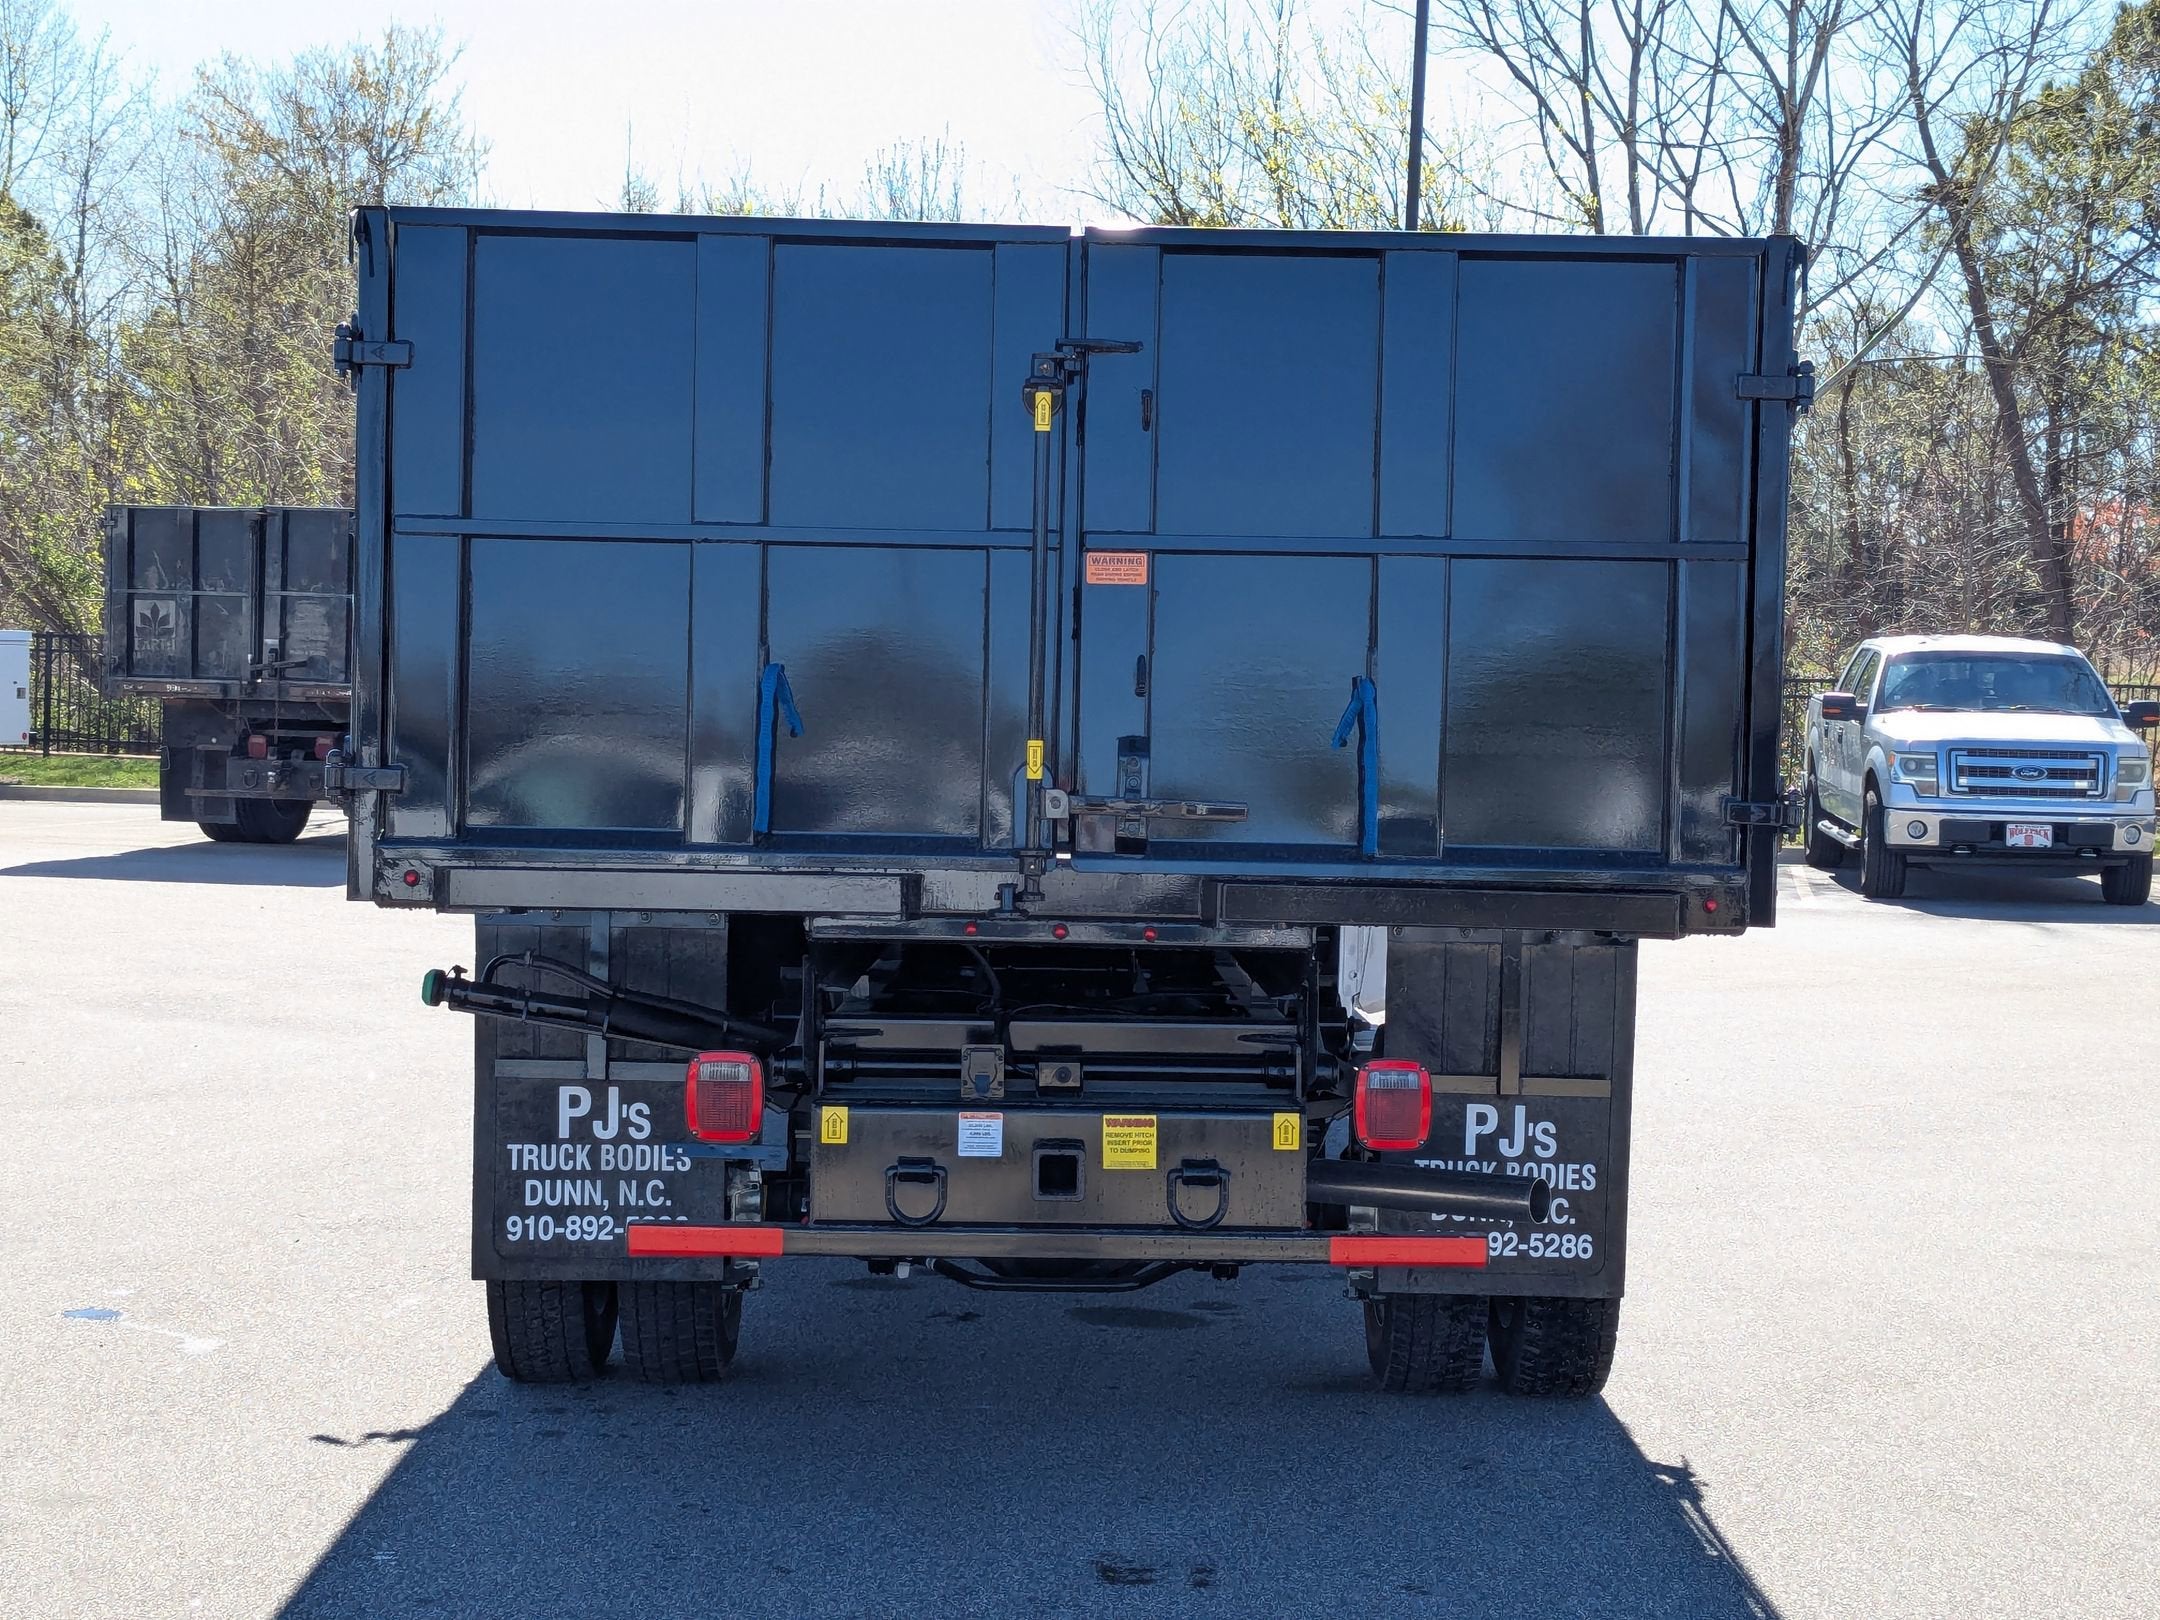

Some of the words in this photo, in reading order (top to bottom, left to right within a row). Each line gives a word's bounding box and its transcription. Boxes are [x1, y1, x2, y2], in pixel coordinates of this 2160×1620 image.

[1091, 557, 1143, 566] WARNING
[2008, 827, 2050, 841] WOLFPACK
[558, 1086, 651, 1139] PJ's
[1105, 1118, 1155, 1128] WARNING
[1465, 1103, 1557, 1158] PJ's
[507, 1144, 591, 1171] TRUCK
[600, 1144, 691, 1172] BODIES
[525, 1180, 609, 1211] DUNN,
[619, 1180, 672, 1206] N.C.
[506, 1216, 688, 1242] 910-892-
